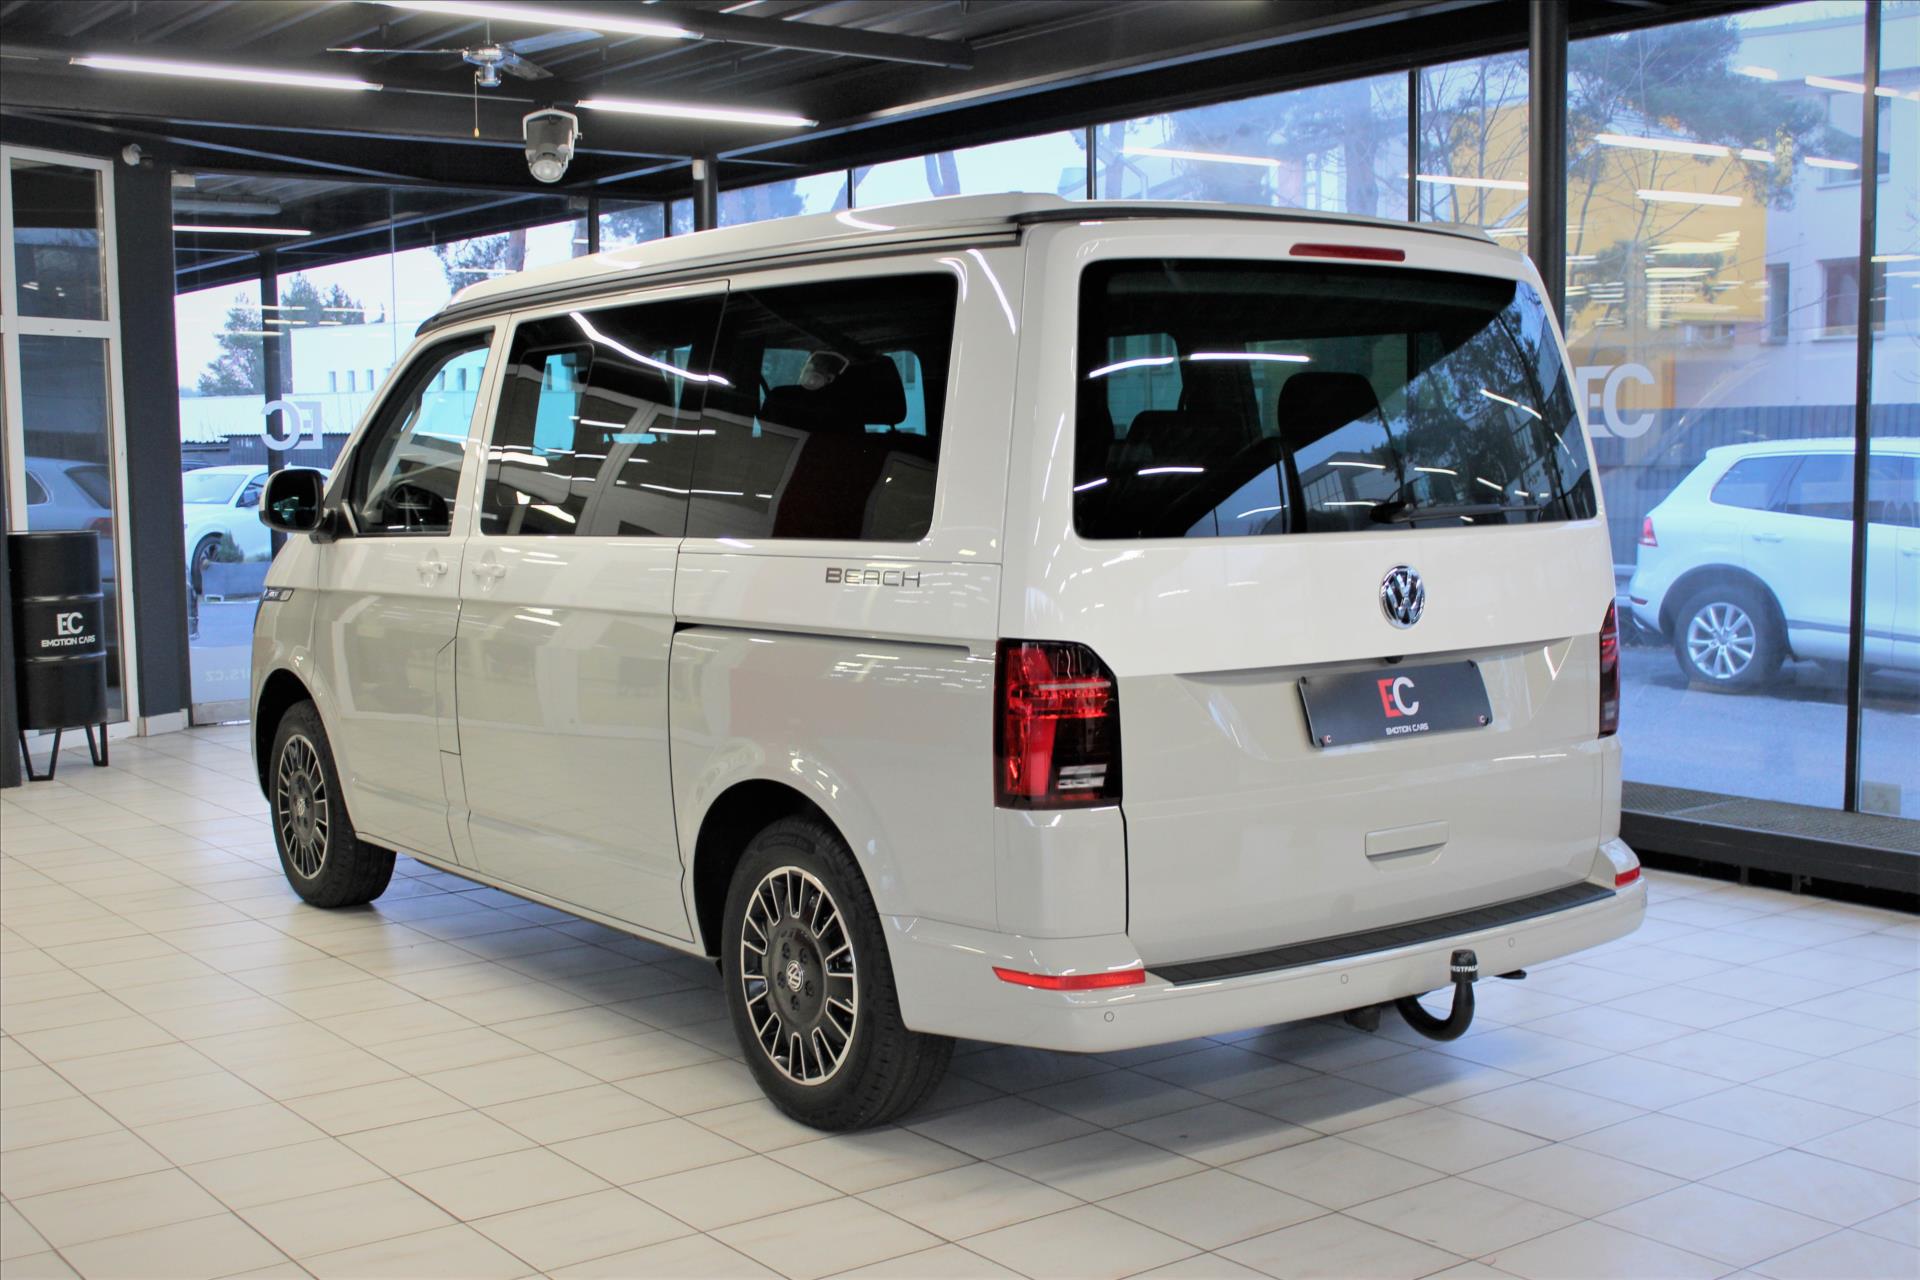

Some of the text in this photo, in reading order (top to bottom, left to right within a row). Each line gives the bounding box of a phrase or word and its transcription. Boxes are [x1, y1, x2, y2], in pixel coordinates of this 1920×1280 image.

[1575, 363, 1655, 438] EC
[825, 567, 921, 588] BEACH
[56, 612, 83, 635] EC
[41, 635, 96, 647] EMOTION CARS
[1377, 676, 1420, 718] EC
[1412, 723, 1429, 732] CARS
